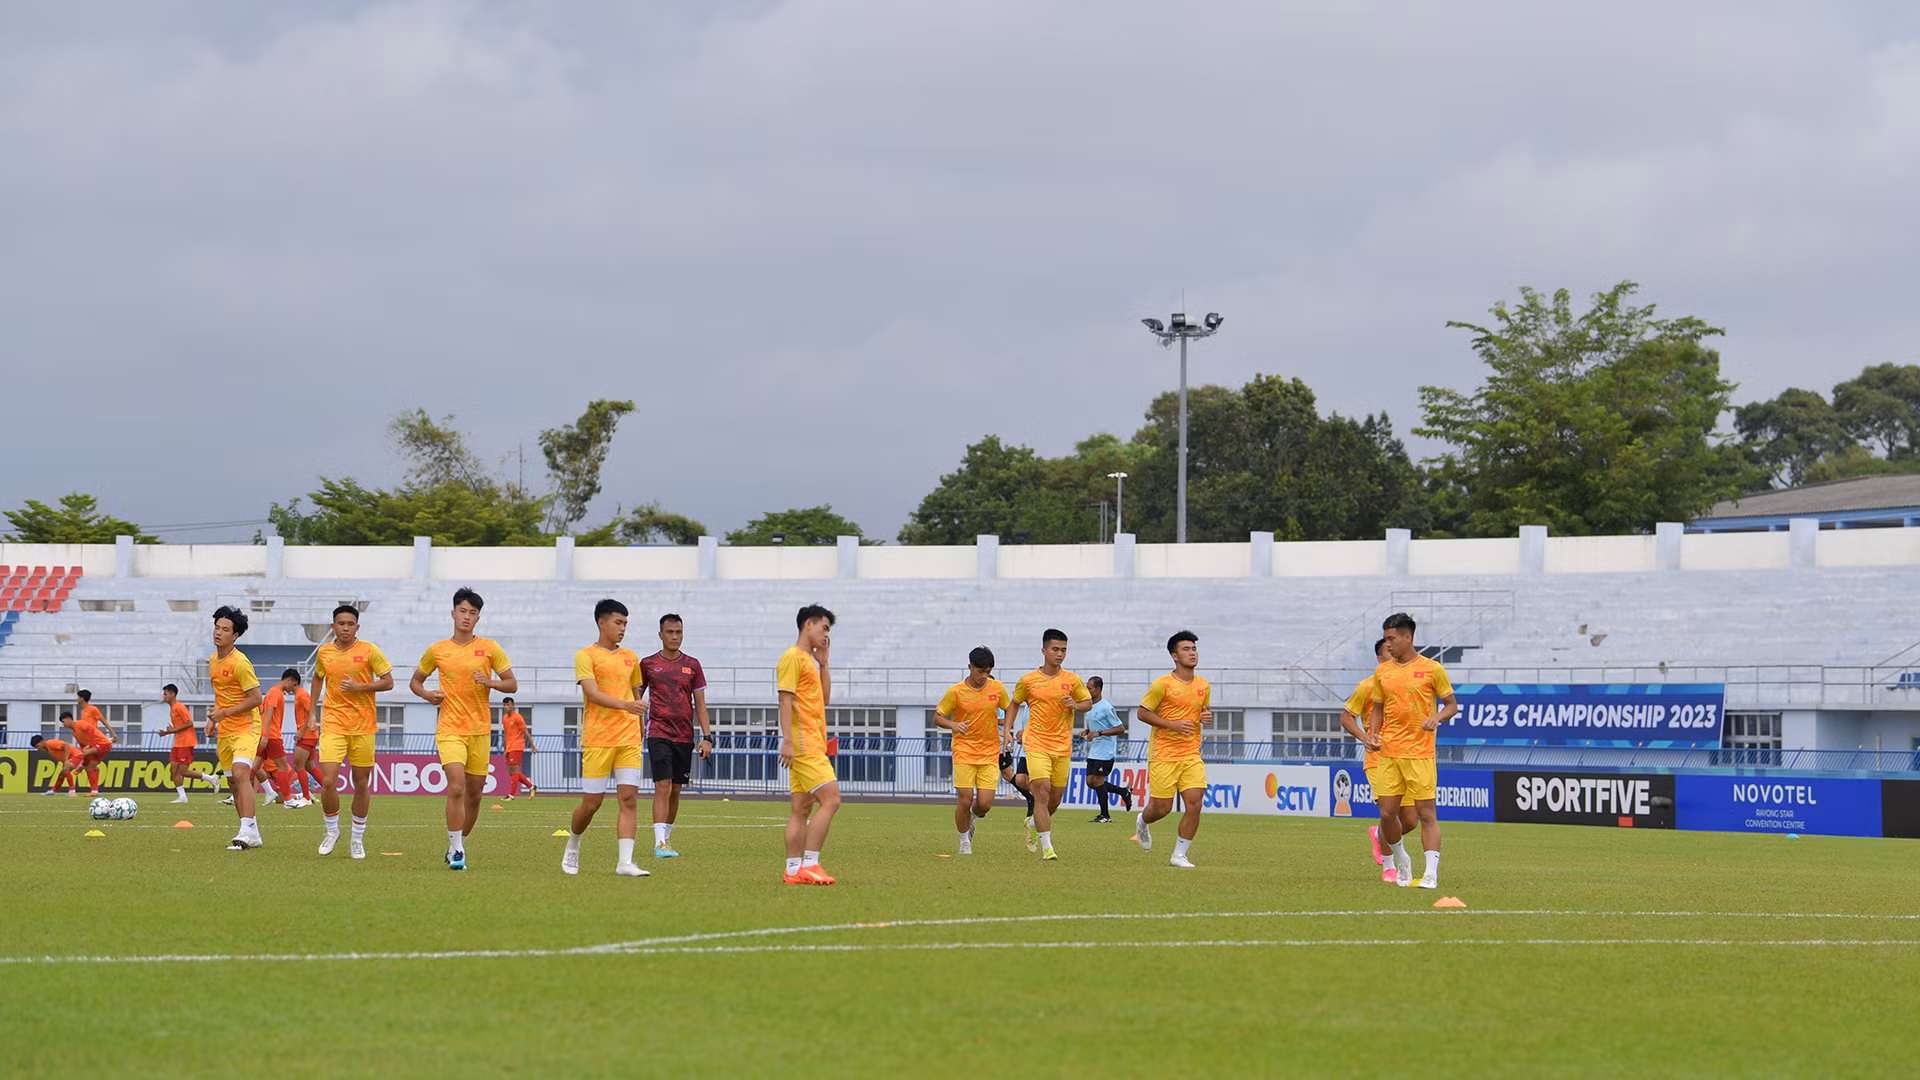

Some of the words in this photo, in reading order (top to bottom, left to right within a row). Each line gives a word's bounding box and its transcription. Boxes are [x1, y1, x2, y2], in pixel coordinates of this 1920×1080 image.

[1468, 704, 1509, 727] U23
[1513, 704, 1666, 728] CHAMPIONSHIP
[1668, 704, 1717, 729] 2023
[1203, 783, 1242, 808] SCTV
[1276, 785, 1317, 811] SCTV
[1436, 786, 1489, 808] EDERATION
[1516, 776, 1651, 815] SPORTFIVE
[1733, 783, 1817, 805] NOVOTEL
[1745, 819, 1782, 828] CONVENTION
[1782, 820, 1805, 830] CENTRE
[1755, 808, 1779, 818] RAYONG
[1780, 809, 1794, 818] STAR
